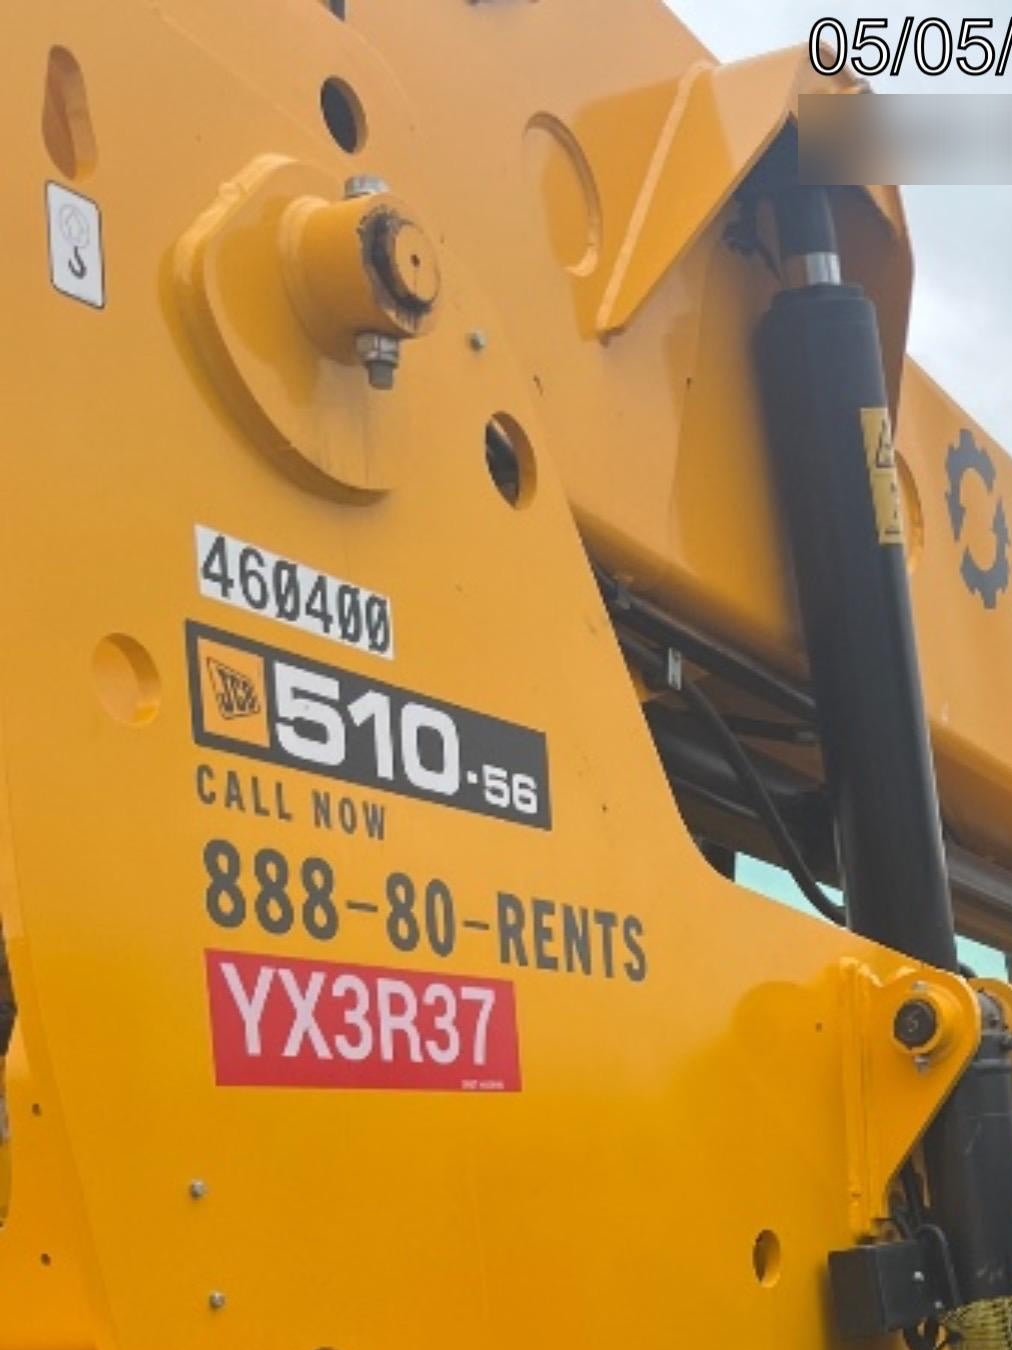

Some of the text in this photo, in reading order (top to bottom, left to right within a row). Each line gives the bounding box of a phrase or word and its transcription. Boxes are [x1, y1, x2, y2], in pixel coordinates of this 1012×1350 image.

[202, 535, 390, 655] 460400
[196, 764, 387, 841] CALL NOW
[203, 839, 648, 983] 888-80-RENTS
[220, 961, 497, 1066] YX3R37
